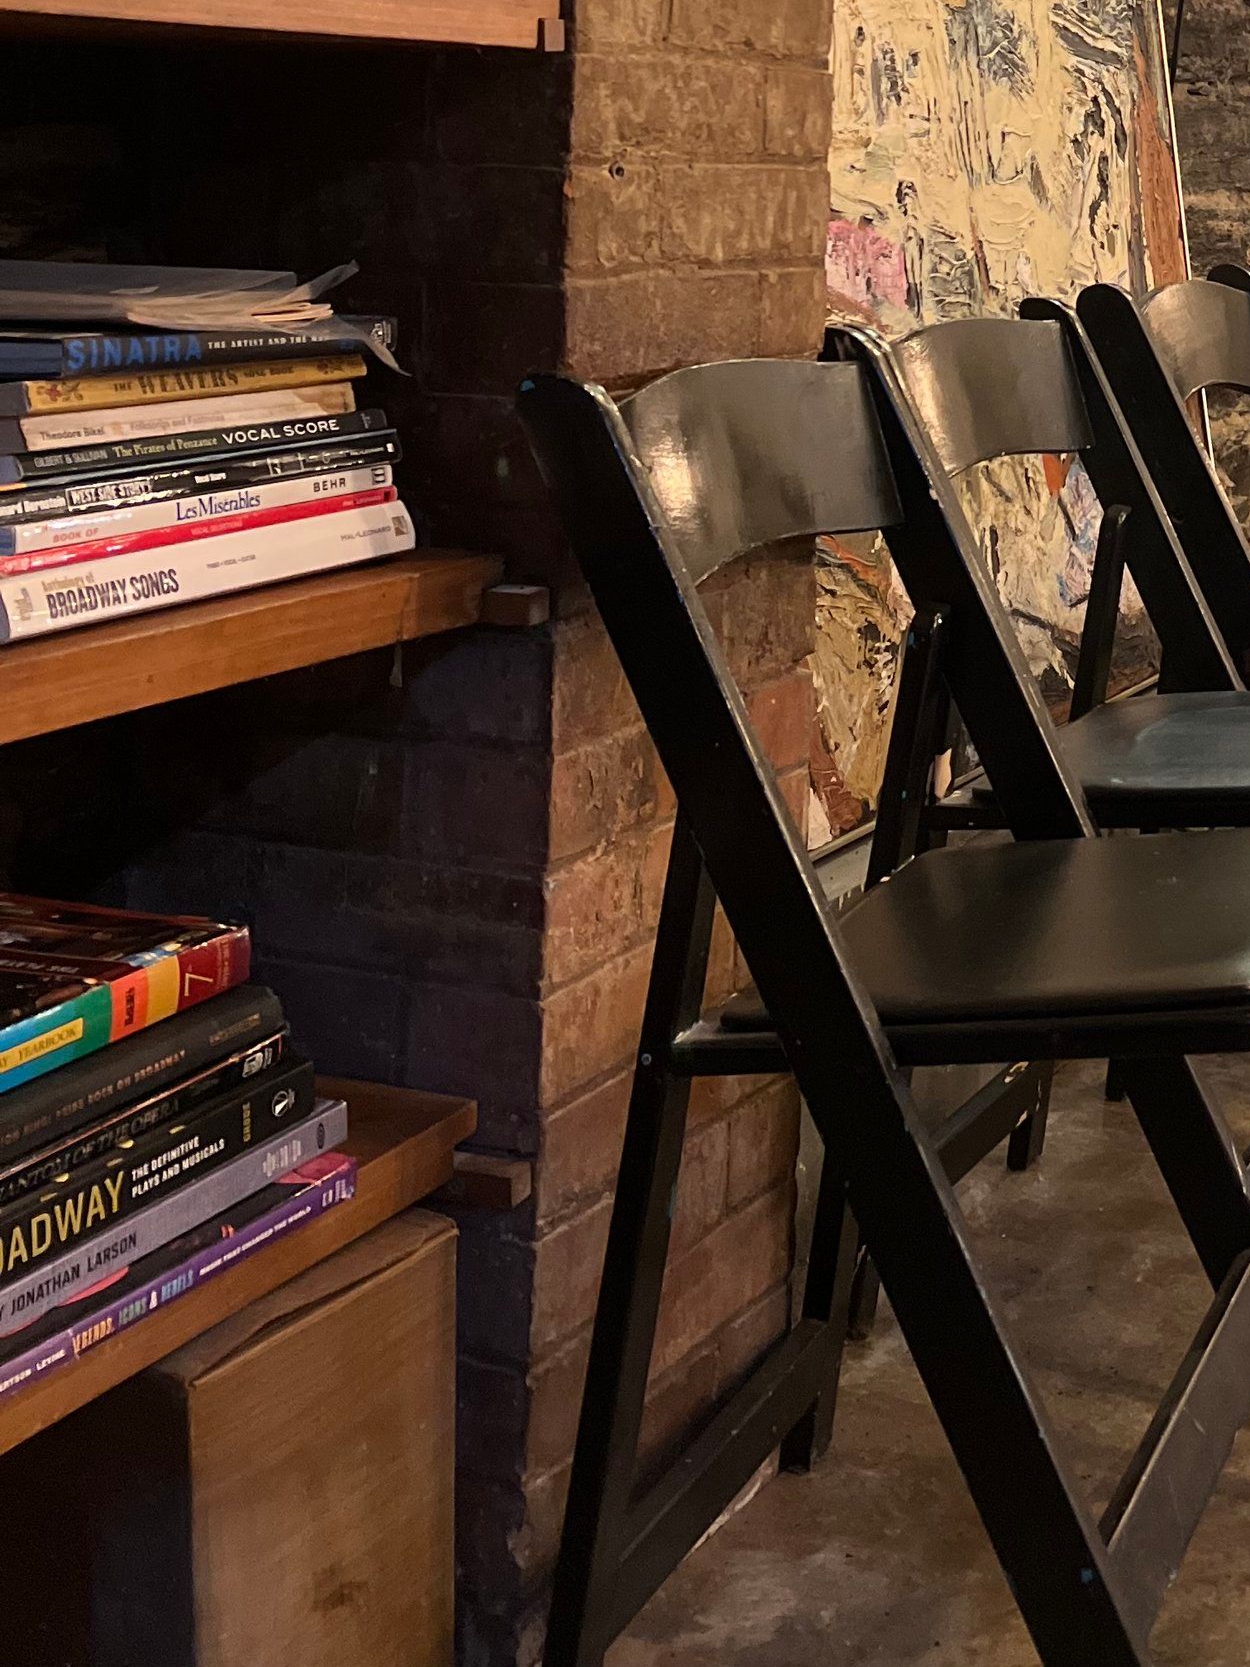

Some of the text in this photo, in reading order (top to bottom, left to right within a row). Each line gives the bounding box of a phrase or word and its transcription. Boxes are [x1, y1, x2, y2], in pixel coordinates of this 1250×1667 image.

[67, 334, 202, 370] SINATRA
[208, 340, 226, 350] THE
[231, 337, 264, 349] ARTIST
[137, 368, 239, 395] WEAVERS
[34, 418, 340, 468] GILBERT & SULLIVAN The Pirates of Penzance VOCAL SCORE
[41, 429, 81, 441] Theodore
[71, 488, 96, 505] WEST
[176, 477, 347, 521] Les Misérables BEHR
[53, 528, 100, 543] BOOK OF
[41, 574, 84, 592] Anthology
[46, 568, 180, 619] BROADWAY SONGS
[18, 1026, 77, 1062] YEARBOOK
[117, 1076, 131, 1090] ON
[134, 1049, 186, 1083] BROADWAY
[130, 1099, 180, 1134] OPERA
[131, 1138, 226, 1199] PLAYS AND MUSICALS
[132, 1136, 200, 1182] THE DEFINITIVE
[11, 1231, 138, 1316] JONATHAN LARSON
[149, 1290, 158, 1310] &
[160, 1269, 194, 1302] REBELS
